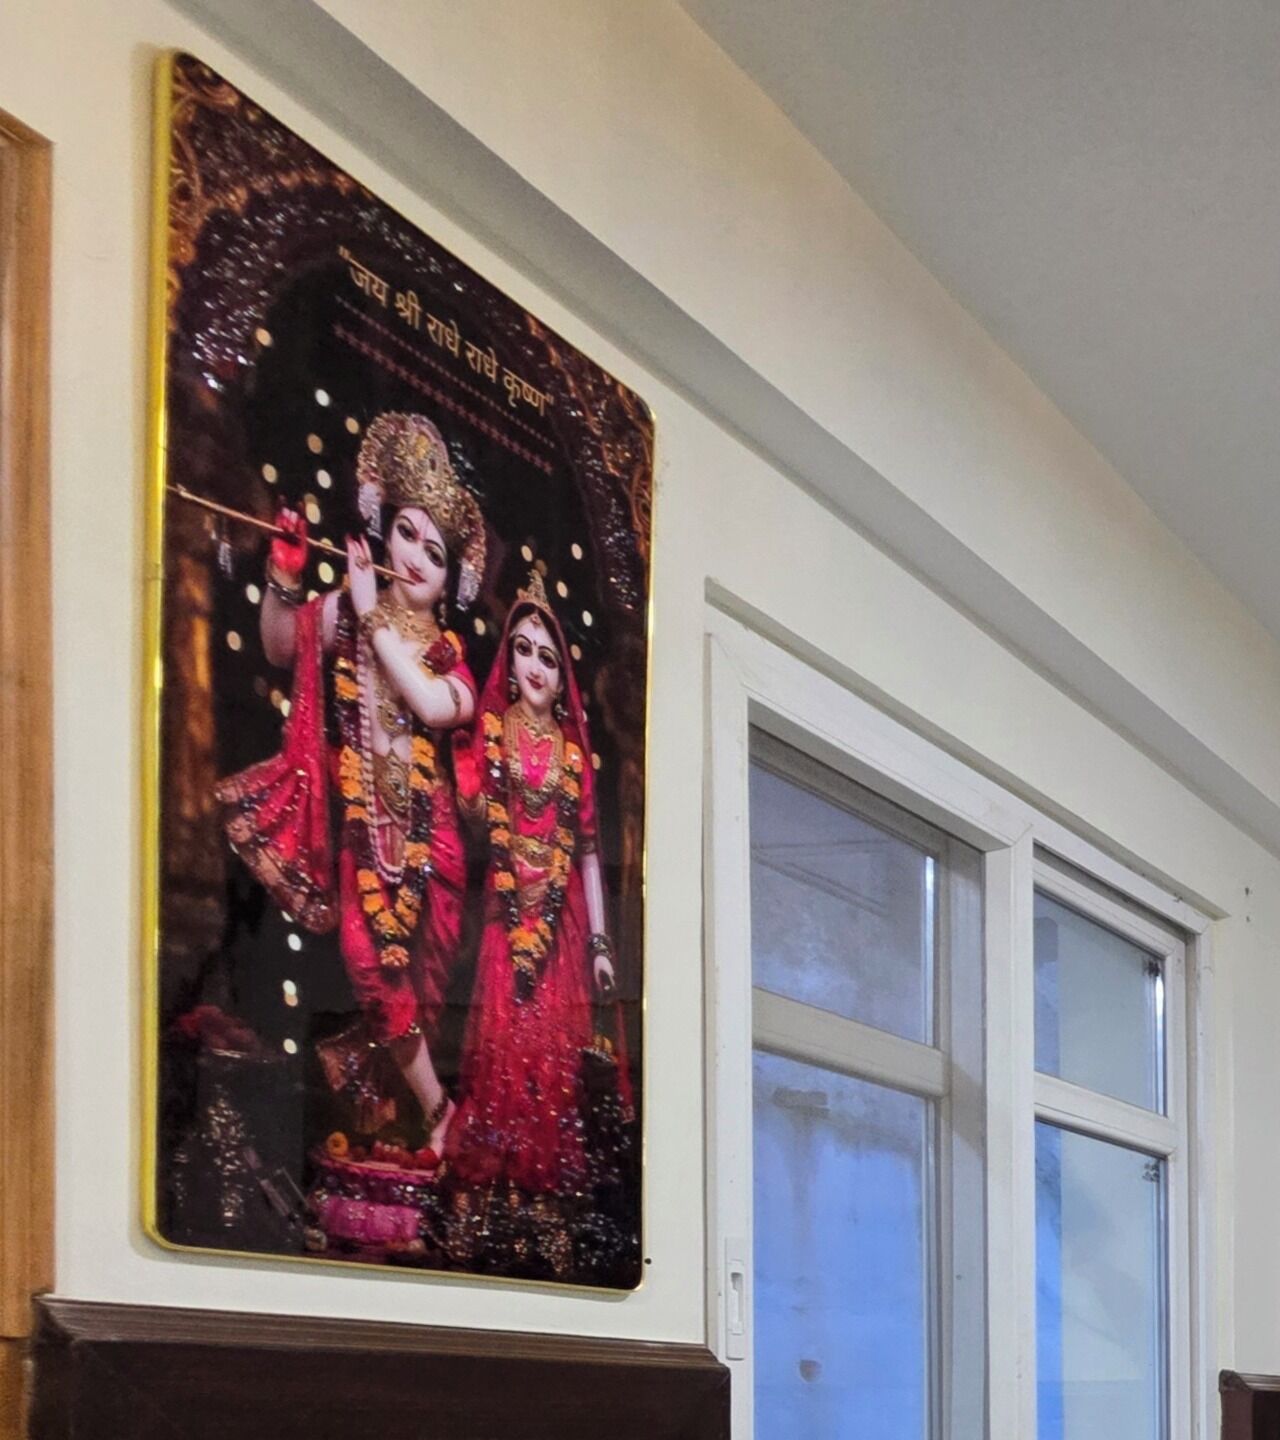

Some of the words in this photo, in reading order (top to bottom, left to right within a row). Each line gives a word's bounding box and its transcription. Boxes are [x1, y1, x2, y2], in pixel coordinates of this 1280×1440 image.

[395, 290, 422, 329] श्री
[427, 313, 460, 359] राधे
[465, 341, 499, 383] राधे
